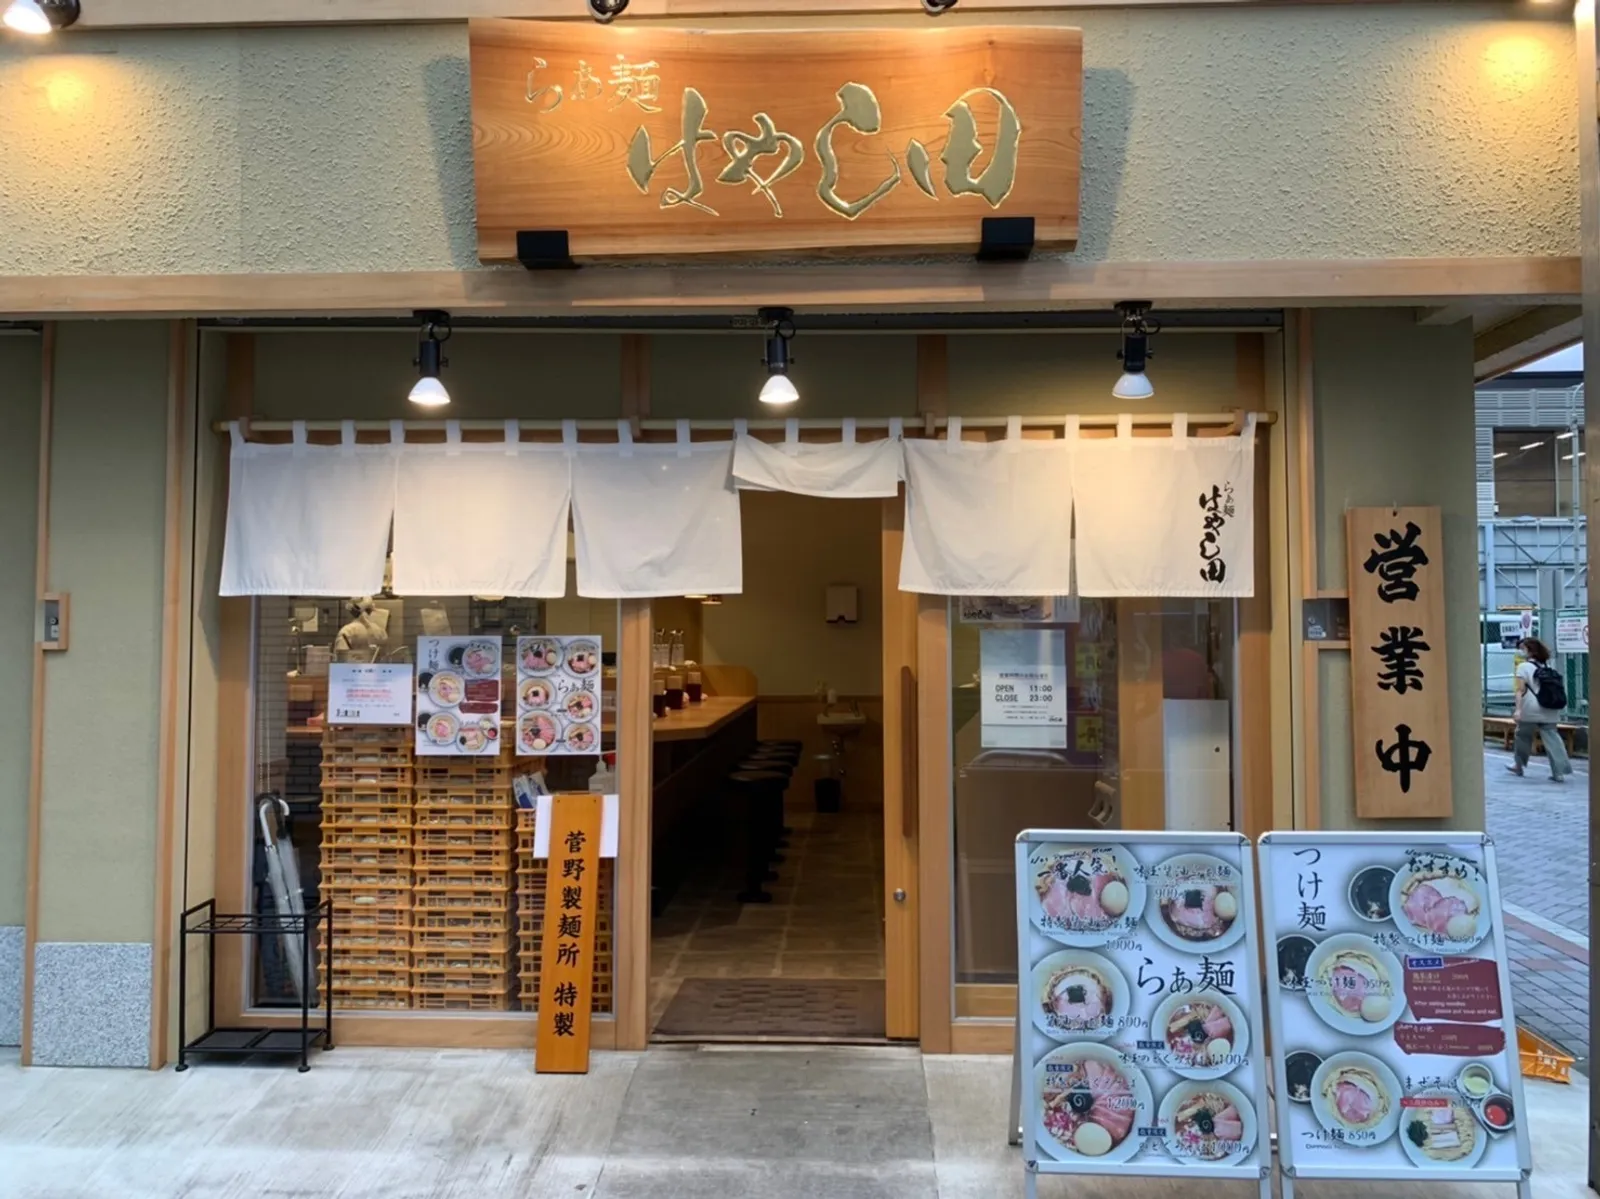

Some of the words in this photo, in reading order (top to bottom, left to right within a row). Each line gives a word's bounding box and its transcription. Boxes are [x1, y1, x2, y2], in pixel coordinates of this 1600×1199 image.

[525, 54, 662, 113] らぁ麺
[626, 81, 1022, 220] はやし田
[1223, 481, 1235, 518] らぁ麺
[1199, 484, 1226, 583] はやし田
[1363, 521, 1432, 793] 営業中
[995, 684, 1014, 693] OPEN
[1029, 685, 1053, 693] 11:00
[995, 694, 1018, 703] CLOSE
[1029, 694, 1053, 703] 23:00
[554, 830, 587, 969] 菅野製麺所
[1293, 847, 1328, 932] つけ麺
[1137, 955, 1237, 996] らぁ麺
[553, 981, 578, 1038] 特製
